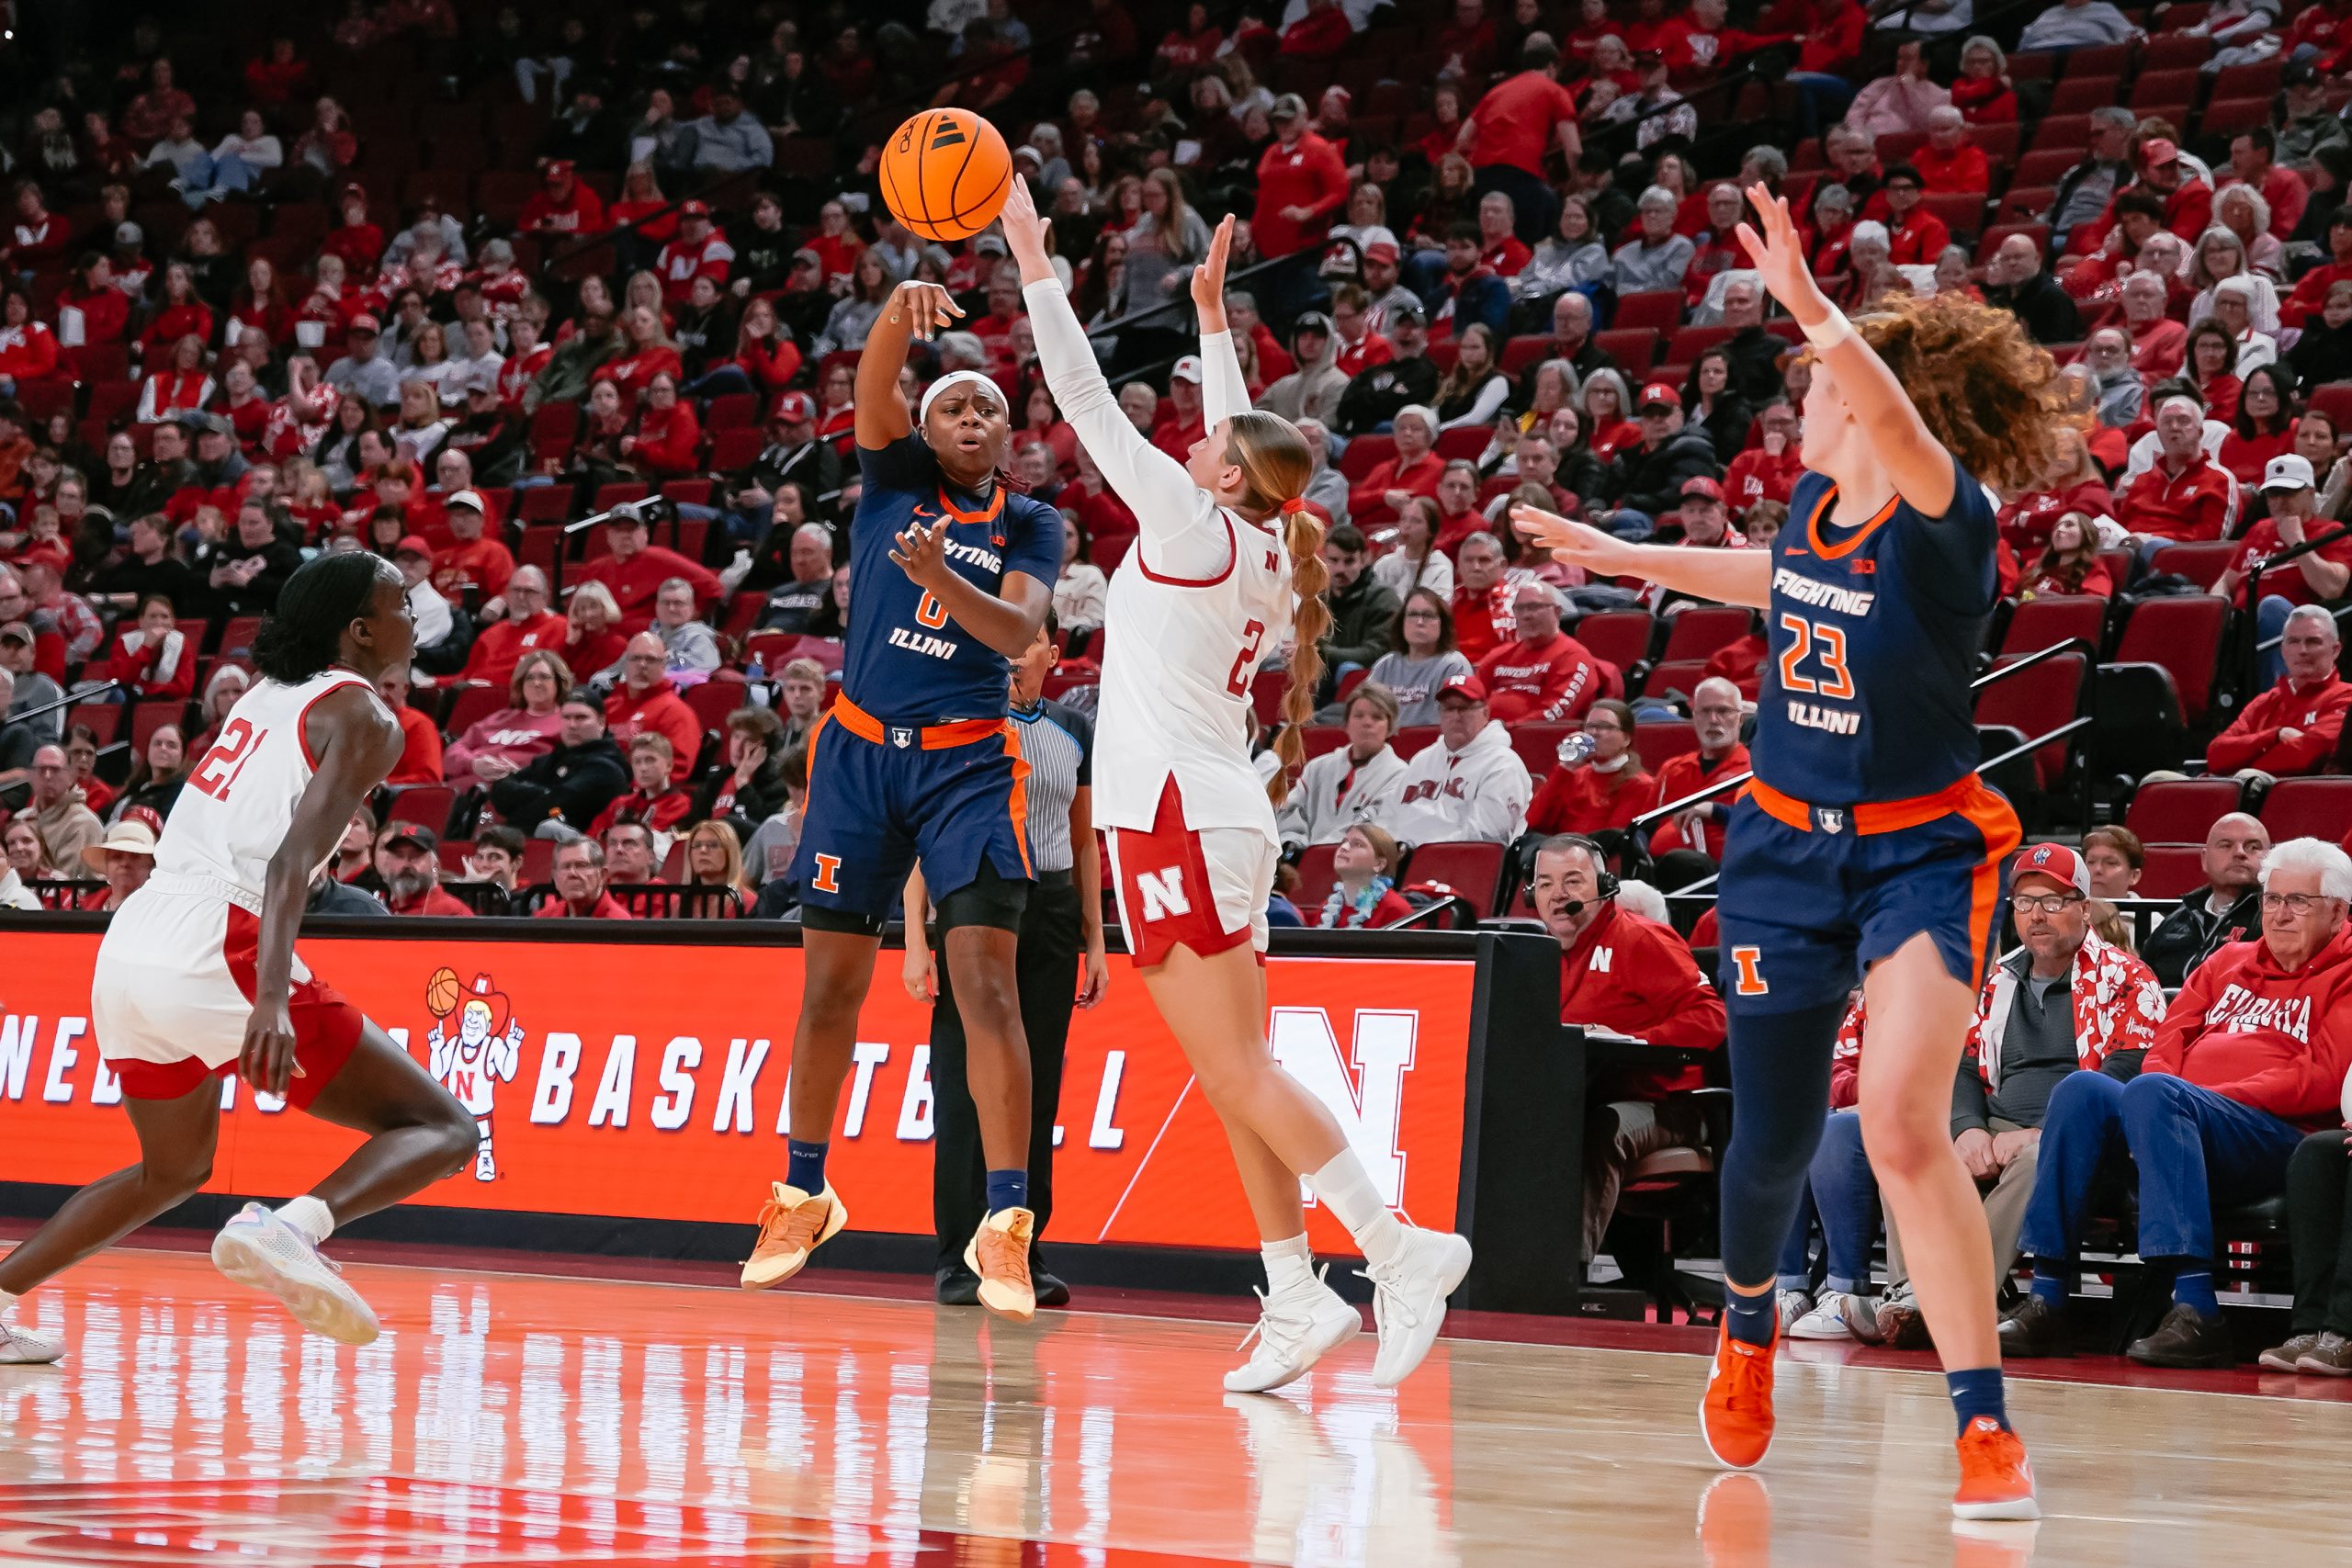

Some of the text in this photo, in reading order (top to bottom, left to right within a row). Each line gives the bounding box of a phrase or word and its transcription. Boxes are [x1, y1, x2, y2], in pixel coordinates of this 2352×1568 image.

[1265, 550, 1278, 573] N
[1772, 567, 1875, 616] FIGHTING
[888, 627, 957, 660] ILLINI
[1227, 618, 1265, 698] 2
[1779, 612, 1855, 700] 23
[1788, 700, 1861, 735] ILLINI
[187, 717, 268, 802] 21
[812, 852, 842, 894] I
[1136, 865, 1191, 922] N
[1589, 945, 1612, 972] N
[1732, 945, 1770, 996] I
[475, 978, 487, 993] N
[454, 1071, 475, 1101] N
[529, 1032, 1125, 1148] BASKTBL
[1269, 1006, 1419, 1211] N
